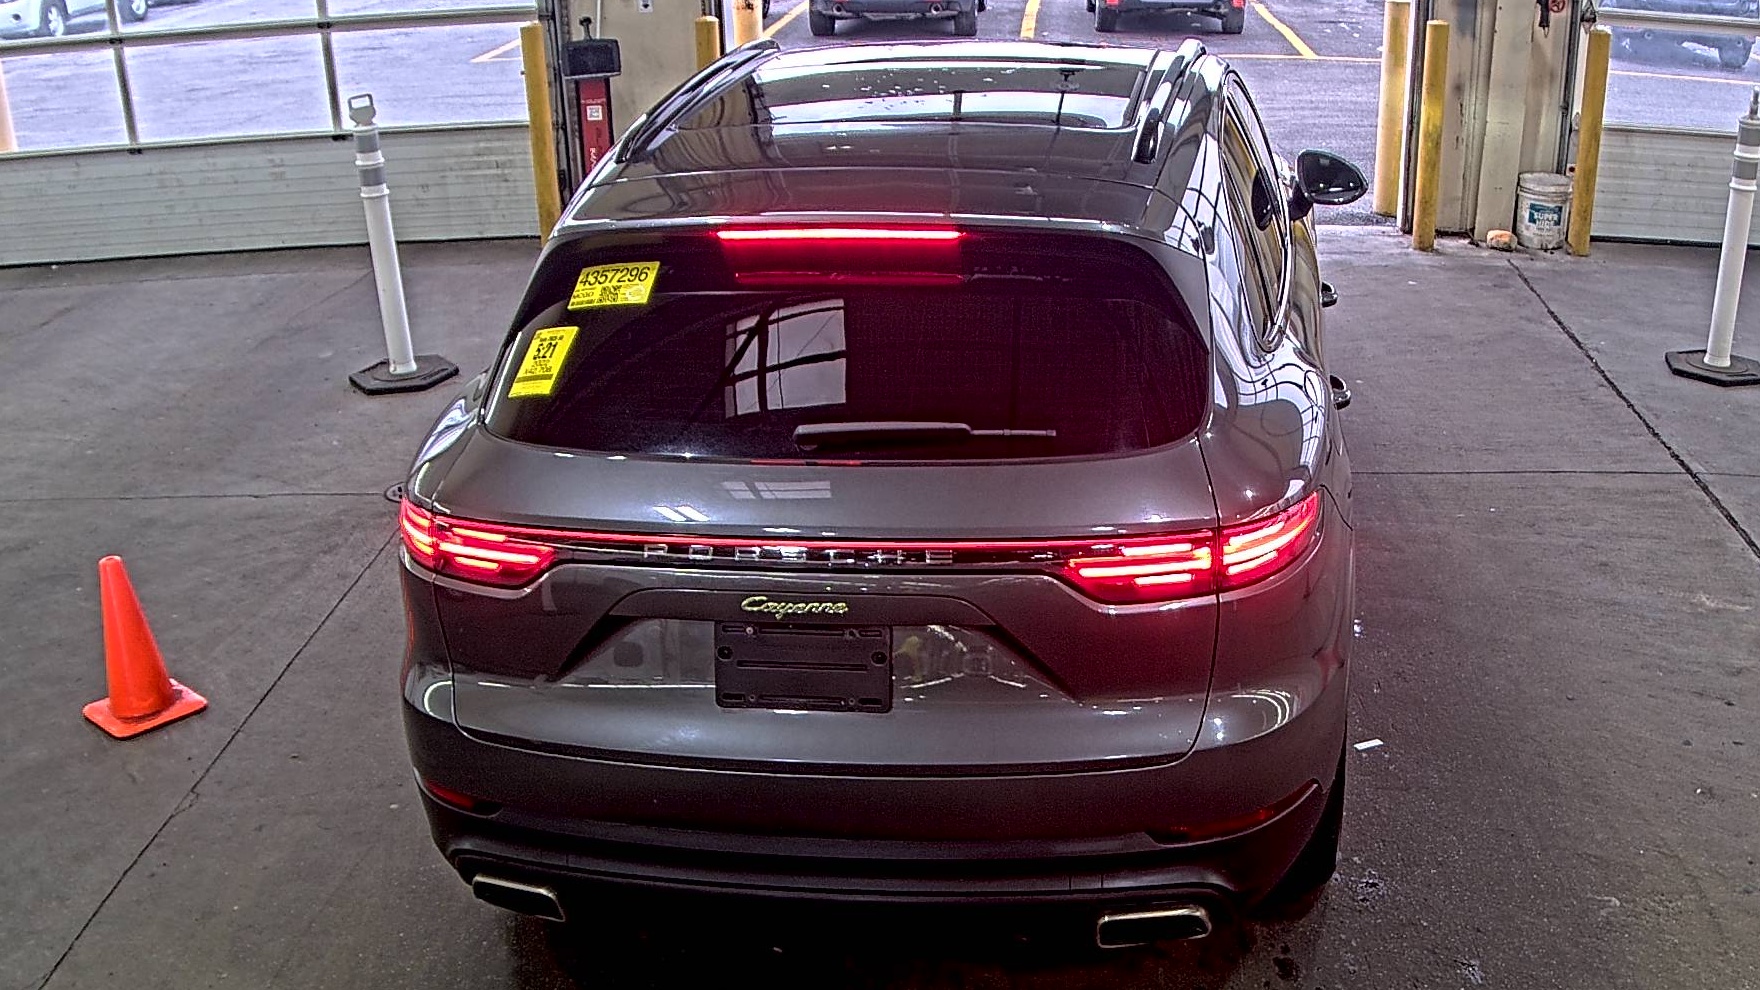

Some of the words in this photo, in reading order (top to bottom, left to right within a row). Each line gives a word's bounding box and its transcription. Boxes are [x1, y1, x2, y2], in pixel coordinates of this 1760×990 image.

[579, 266, 651, 287] 4357296
[643, 543, 954, 564] PORSCHE
[740, 595, 849, 620] Cayenne
